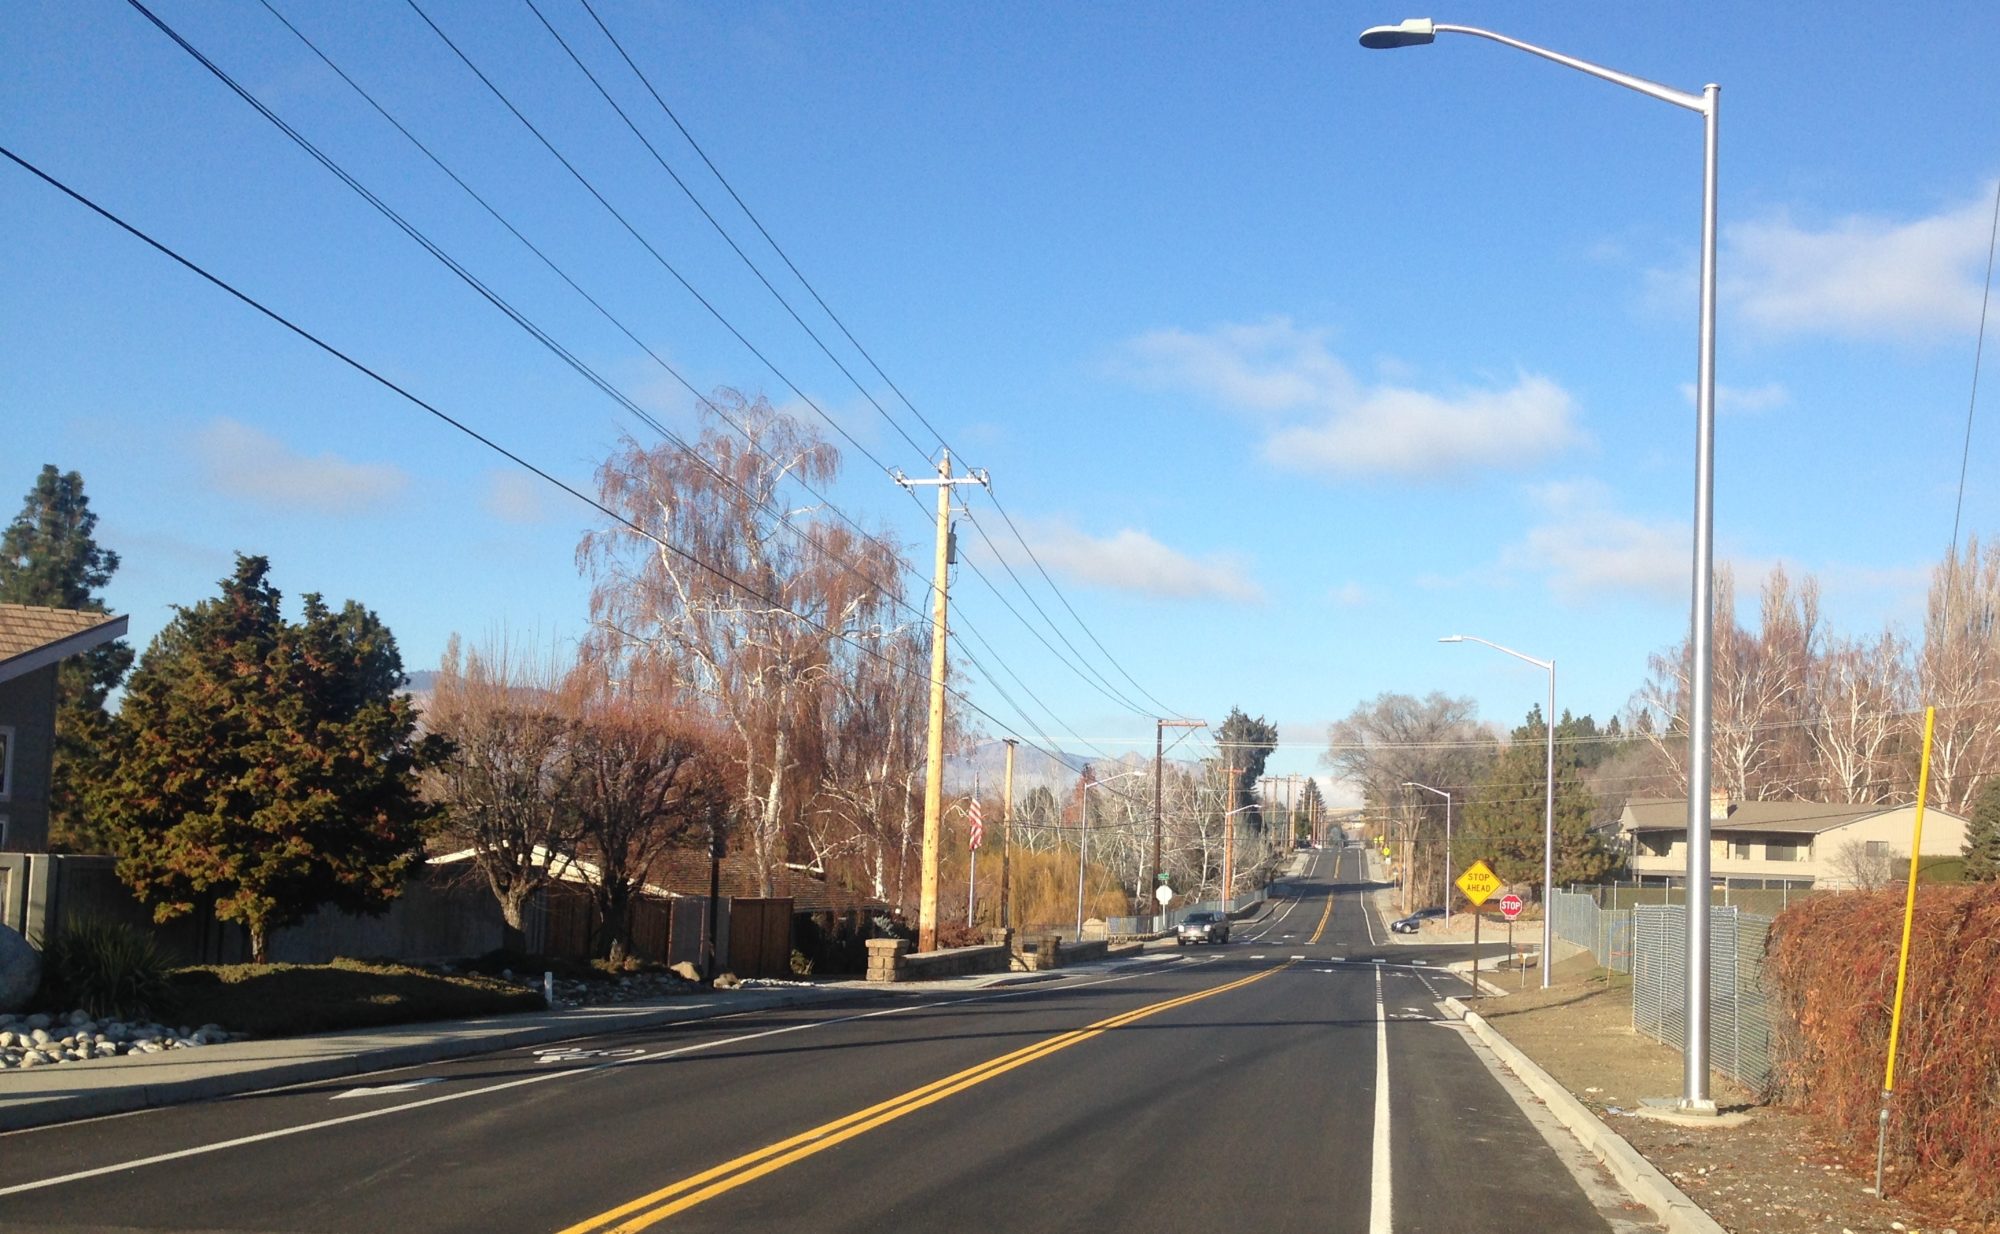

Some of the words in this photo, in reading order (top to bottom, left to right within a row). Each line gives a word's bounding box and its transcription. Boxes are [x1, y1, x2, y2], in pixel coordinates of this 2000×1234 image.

[1467, 873, 1490, 881] STOP
[1467, 884, 1491, 892] AHEAD
[1501, 901, 1521, 910] STOP
